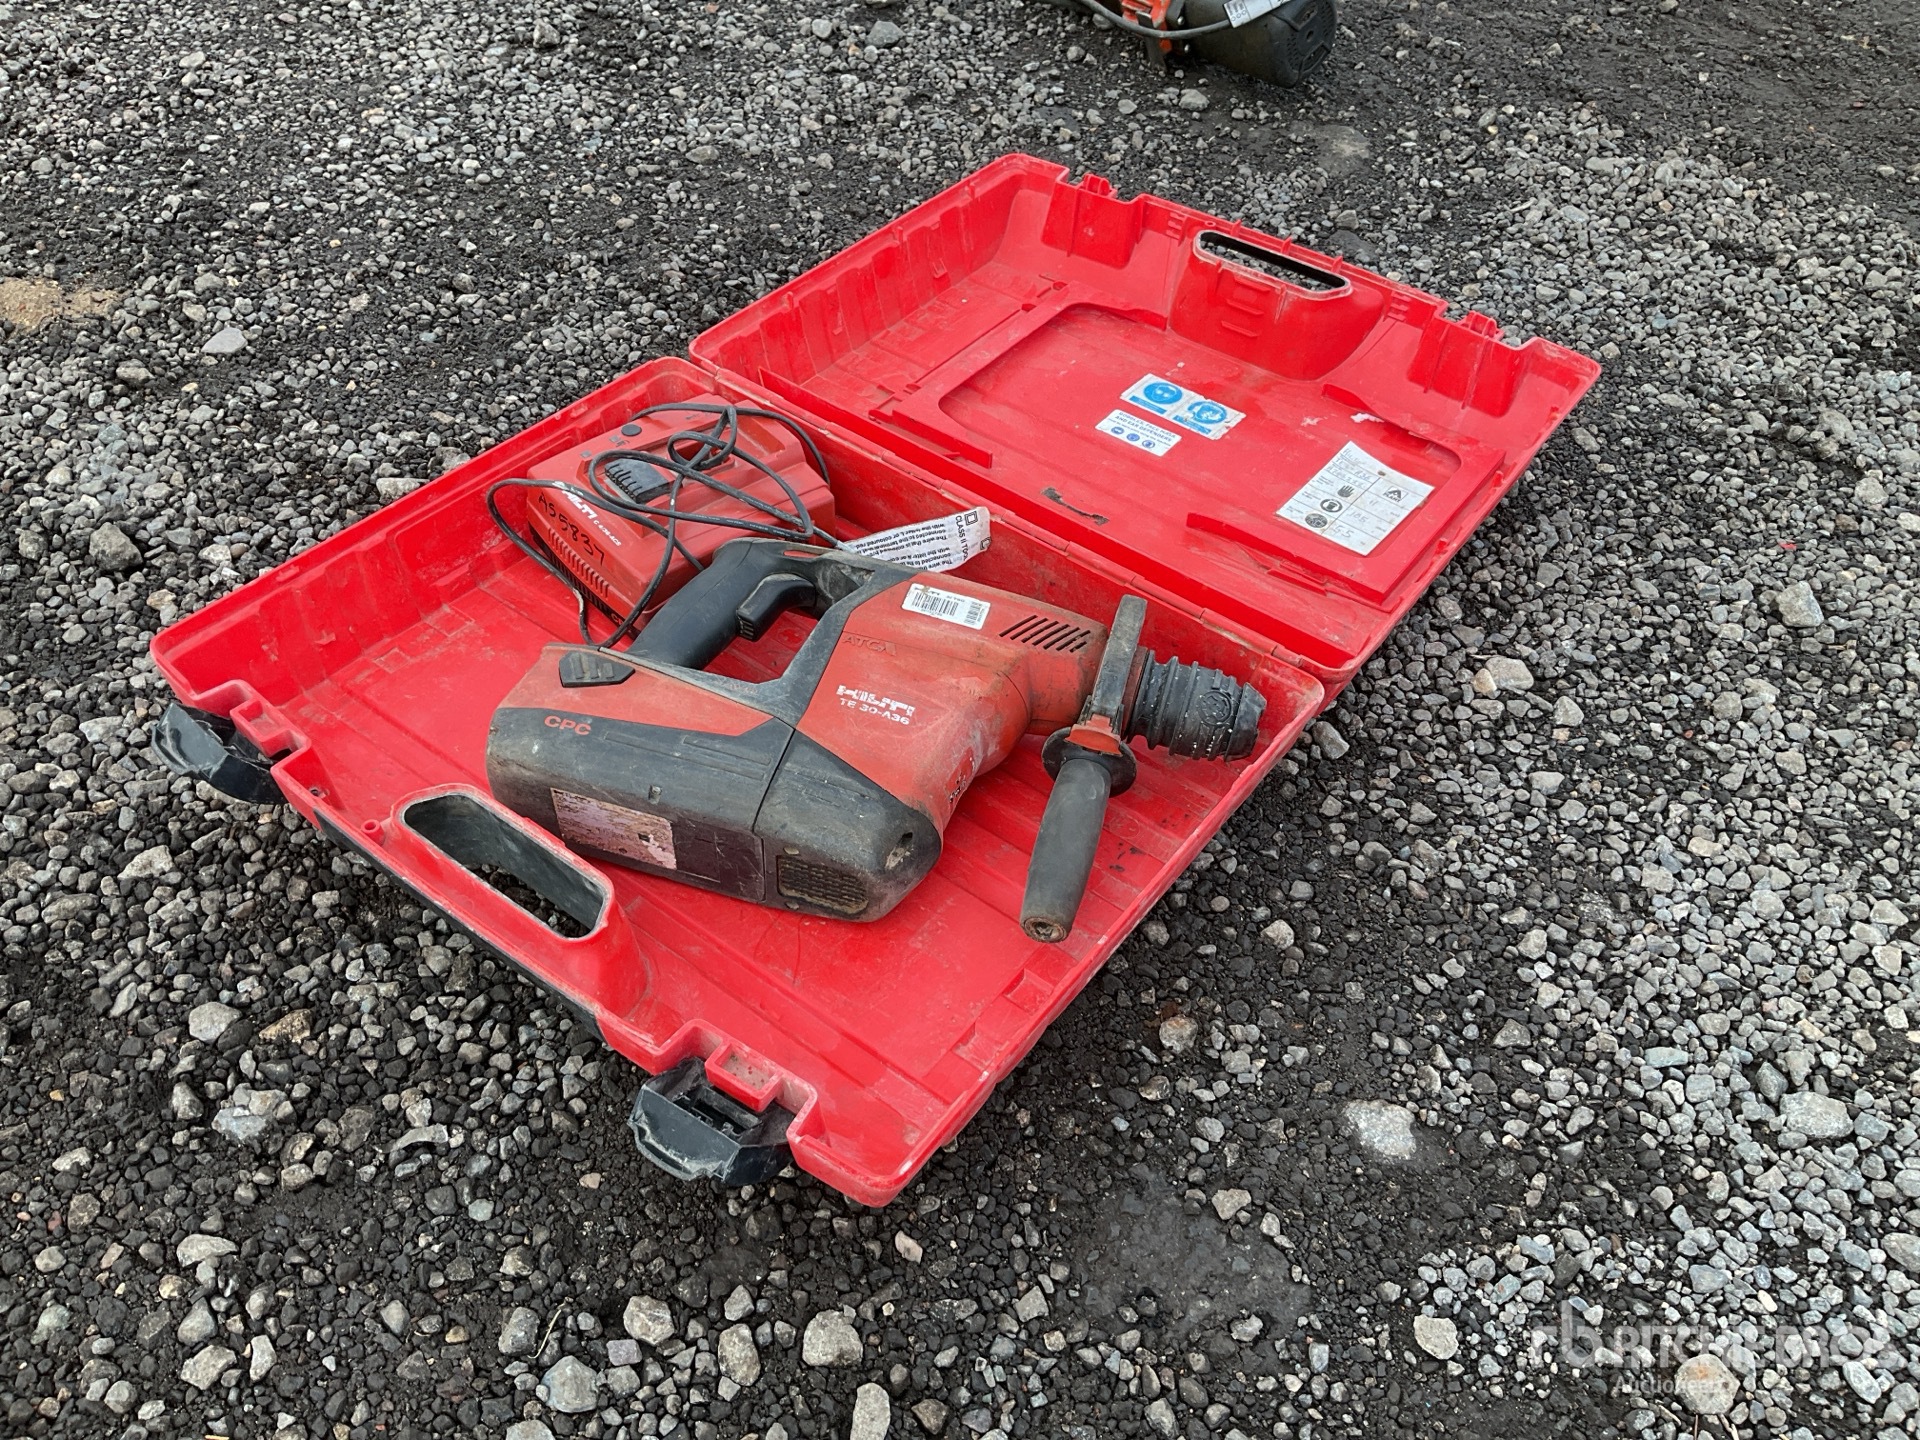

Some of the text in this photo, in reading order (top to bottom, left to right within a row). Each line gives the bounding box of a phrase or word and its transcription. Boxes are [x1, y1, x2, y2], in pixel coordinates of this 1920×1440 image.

[1114, 415, 1173, 442] AND EAR DEFENDERS
[1145, 422, 1160, 432] FACE
[915, 529, 946, 539] connected
[955, 515, 966, 538] CLASS
[866, 535, 892, 547] coloured
[921, 552, 951, 564] connected
[836, 684, 916, 717] HILTI
[839, 697, 911, 725] TE 30-A36
[544, 715, 592, 736] CPC
